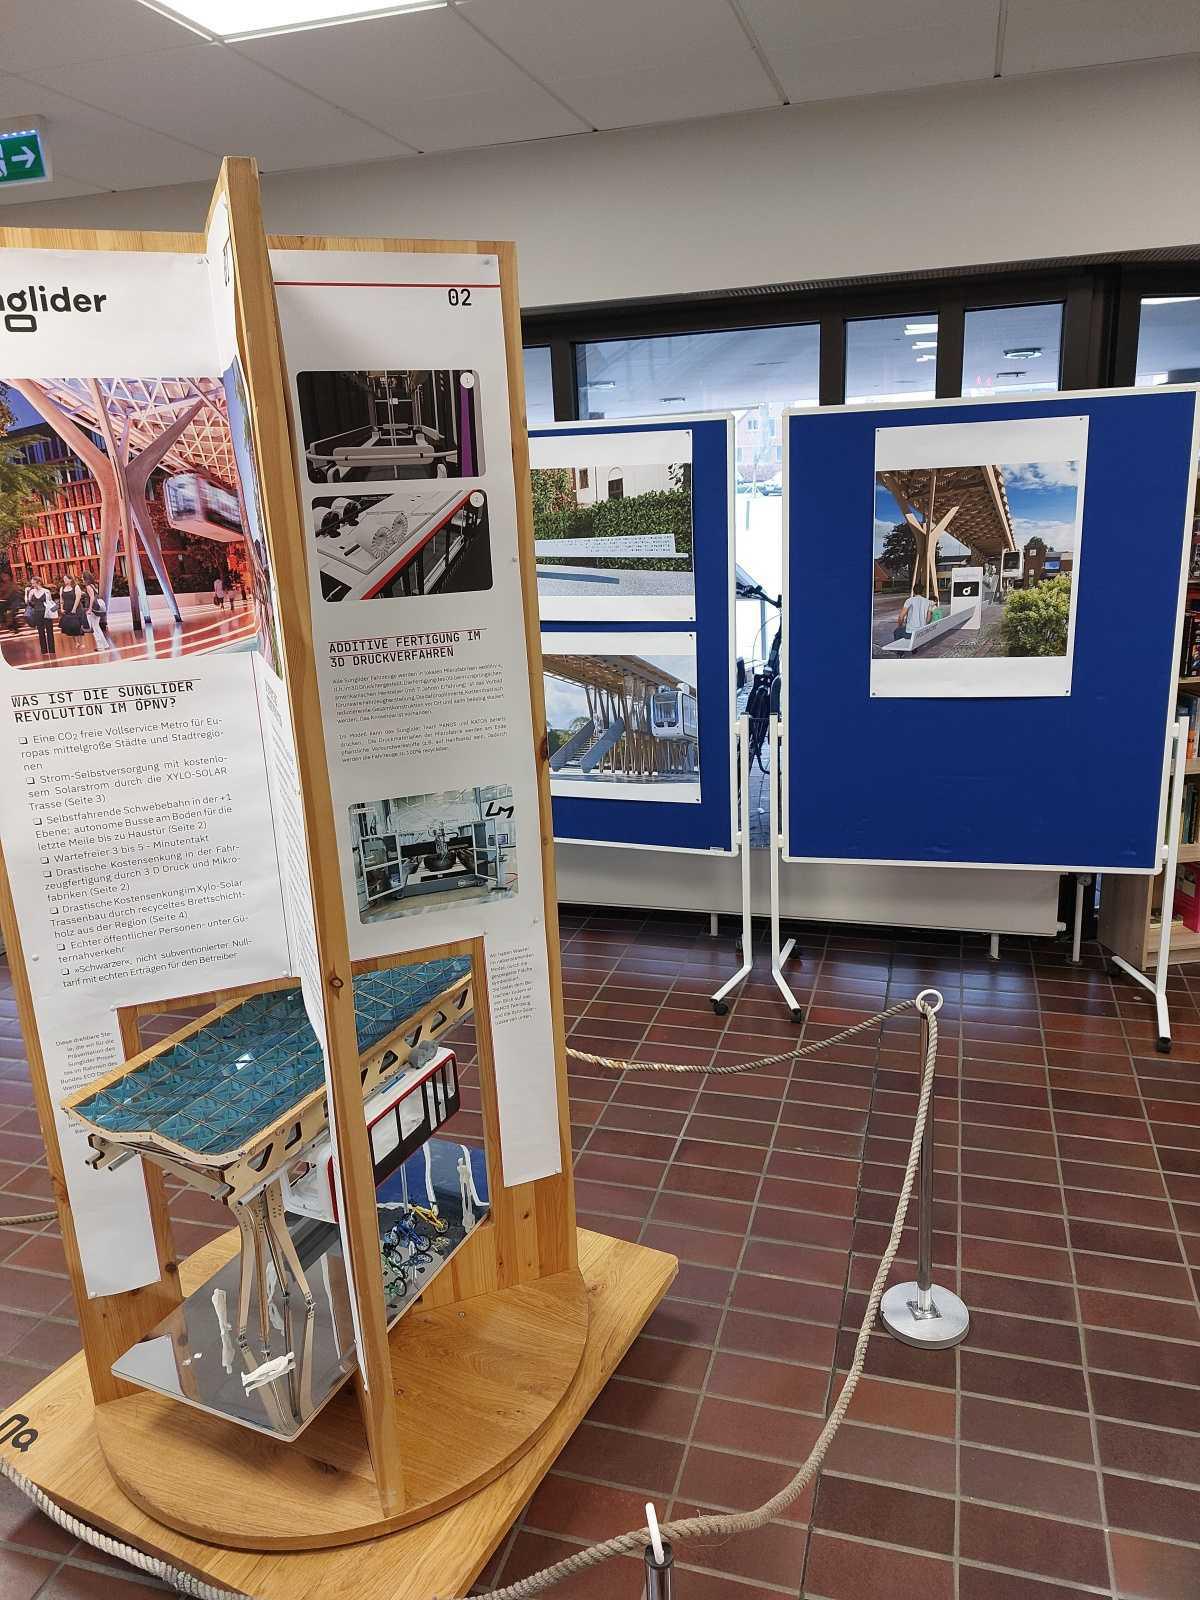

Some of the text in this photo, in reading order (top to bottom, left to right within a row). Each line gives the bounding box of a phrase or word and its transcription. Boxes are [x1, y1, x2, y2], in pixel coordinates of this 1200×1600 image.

[0, 285, 107, 333] glider
[448, 288, 472, 306] 02
[329, 630, 482, 654] ADDITIVE FERTIGUNG IM
[330, 646, 455, 668] 3D DRUCKVERFAHREN
[11, 681, 194, 708] WAS IST DIE SUNGLIDER
[14, 697, 176, 723] REVOLUTION IM ÖPNV?
[33, 734, 55, 744] Eine
[80, 729, 103, 738] freie
[105, 723, 158, 736] Vollservice
[160, 722, 188, 731] Metro
[191, 718, 204, 727] für
[206, 717, 222, 726] Eu-
[21, 730, 223, 759] ropas mittelgroße Städte und Stadtregio-
[24, 763, 43, 771] nen
[40, 763, 160, 784] Strom-Selbstversorgung
[164, 760, 180, 769] mit
[28, 767, 227, 798] sem Solarstrom durch die XYLO-SOLAR
[30, 794, 106, 811] Trasse (Seite 3)
[46, 808, 122, 824] Selbstfahrende
[123, 800, 190, 814] Schwebebahn
[191, 797, 201, 805] in
[202, 796, 218, 804] der
[73, 821, 122, 834] autonome
[125, 817, 154, 827] Busse
[155, 815, 170, 823] am
[172, 810, 202, 821] Boden
[204, 807, 216, 816] für
[219, 806, 232, 815] die
[37, 841, 66, 851] letzte
[69, 837, 95, 846] Meile
[97, 834, 112, 843] bis
[114, 833, 126, 841] zu
[128, 828, 165, 839] Haustür
[168, 824, 195, 833] (Seite
[53, 849, 109, 863] Wartefreier
[112, 847, 118, 855] 3
[121, 845, 136, 854] bis
[137, 843, 144, 851] 5
[153, 835, 208, 849] Minutentakt
[45, 874, 112, 891] zeugfertigung
[114, 870, 141, 880] durch
[162, 862, 190, 873] Druck
[192, 859, 210, 869] und
[212, 856, 240, 866] Mikro-
[56, 863, 107, 877] Drastische
[111, 853, 182, 869] Kostensenkung
[197, 848, 211, 856] der
[216, 844, 240, 854] Fahr-
[47, 882, 130, 903] fabriken (Seite 2)
[62, 899, 113, 913] Drastische
[196, 880, 242, 893] Xylo-Solar
[50, 912, 106, 927] Trassenbau
[108, 907, 136, 918] durch
[187, 891, 246, 906] Brettschicht-
[54, 910, 188, 939] holz aus der Region (Seite 4)
[70, 939, 102, 950] Echter
[207, 918, 231, 927] unter
[58, 946, 125, 963] ternahverkehr
[136, 953, 157, 963] nicht
[160, 943, 229, 959] subventionierter
[232, 937, 252, 947] Null-
[63, 978, 82, 988] tarif
[82, 975, 97, 985] mit
[98, 970, 129, 982] echten
[129, 963, 167, 976] Erträgen
[167, 961, 179, 970] für
[181, 958, 198, 967] den
